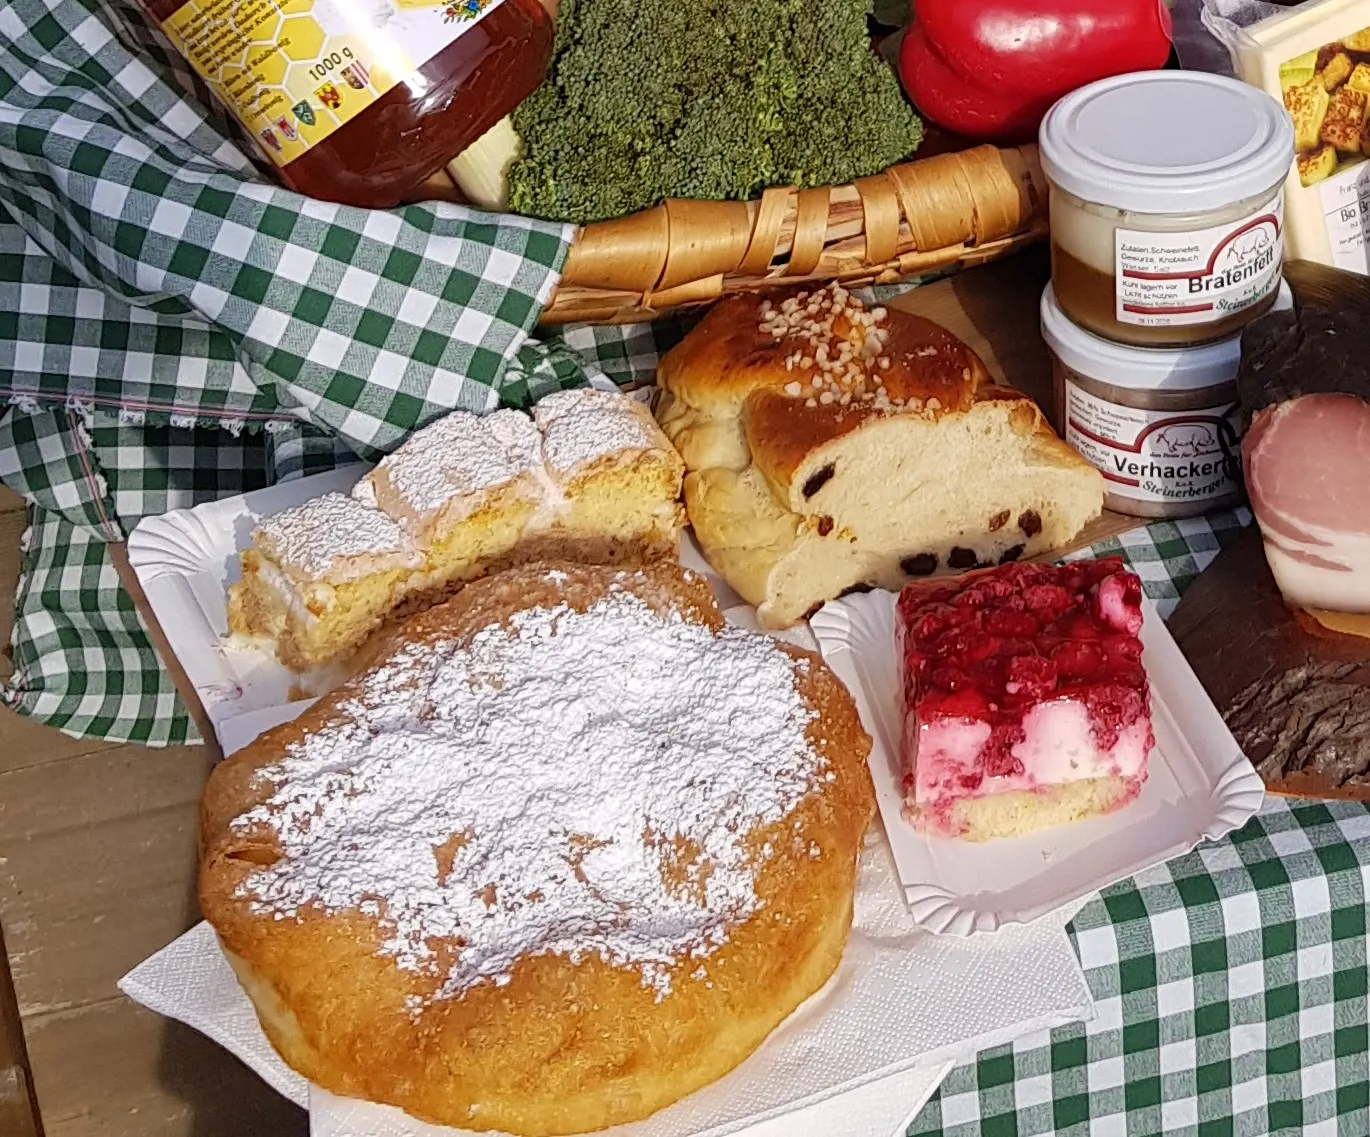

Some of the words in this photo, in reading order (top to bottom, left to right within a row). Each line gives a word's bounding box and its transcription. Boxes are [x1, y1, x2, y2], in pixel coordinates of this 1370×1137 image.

[308, 52, 343, 82] 1000
[342, 46, 354, 60] g
[1188, 246, 1274, 293] Bratenfett
[1142, 475, 1226, 498] Steinerberger
